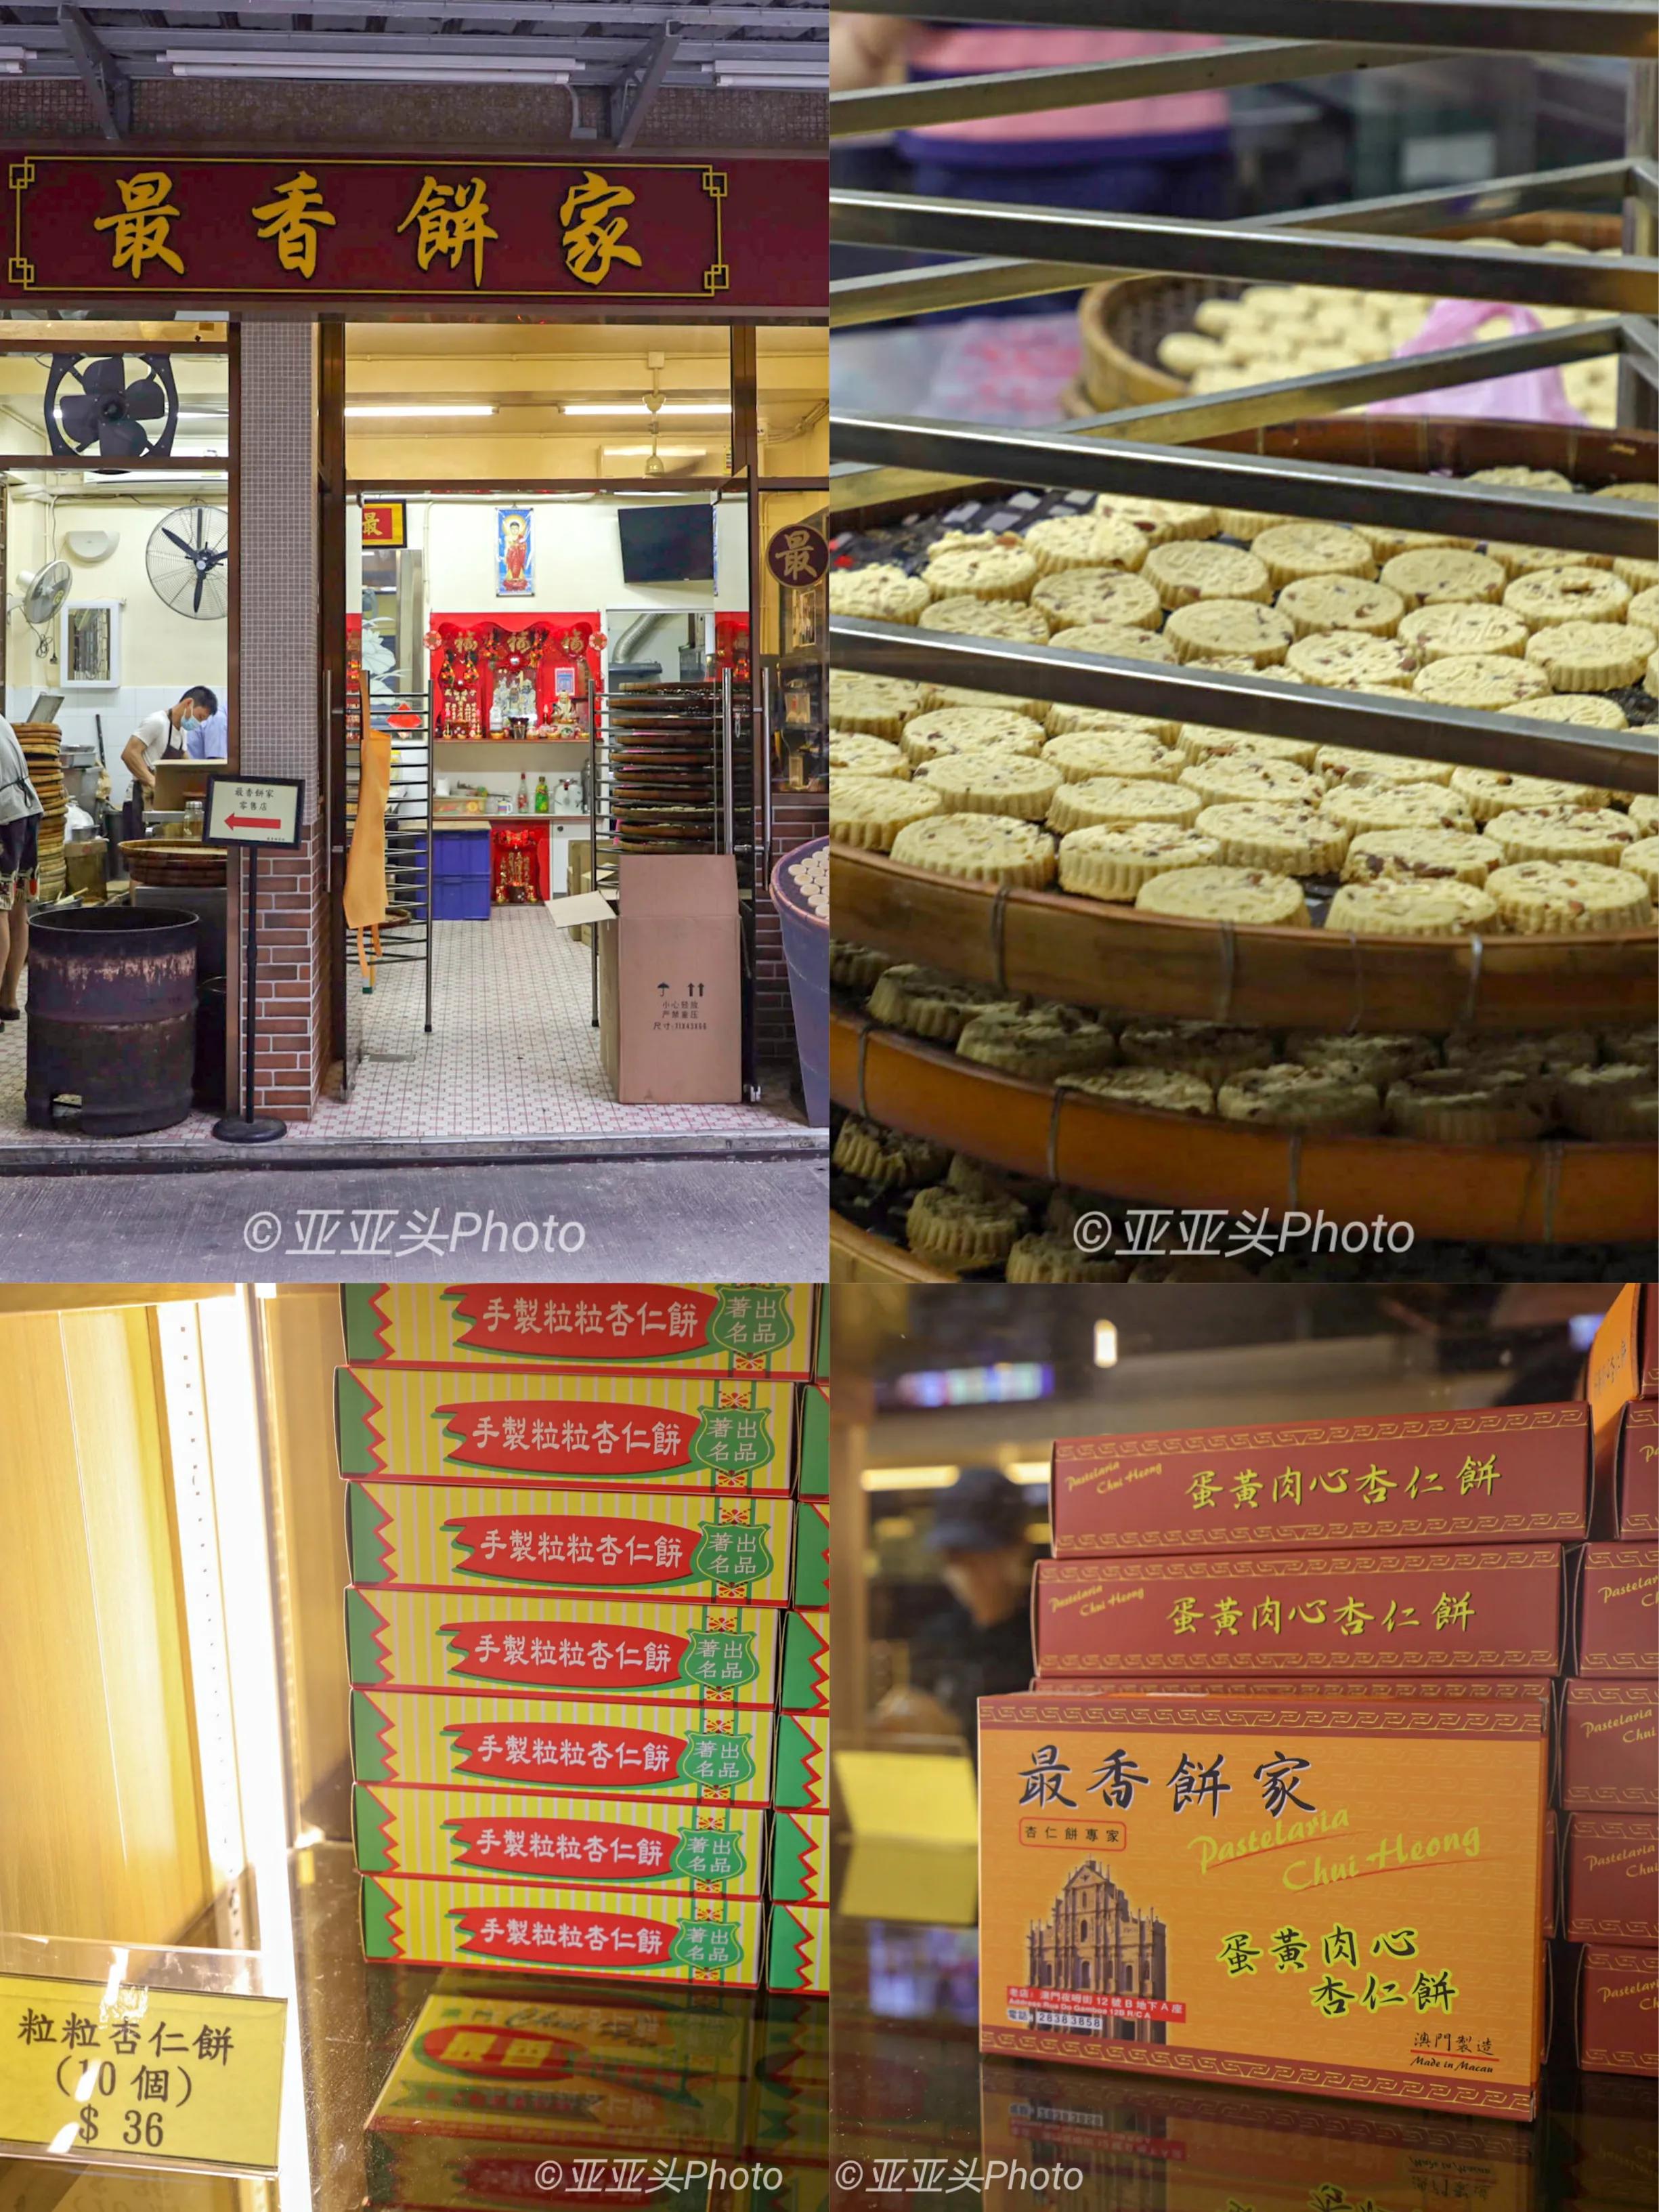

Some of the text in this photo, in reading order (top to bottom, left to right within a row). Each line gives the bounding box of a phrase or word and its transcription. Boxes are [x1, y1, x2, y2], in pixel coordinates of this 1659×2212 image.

[93, 170, 643, 289] 最香餅家
[775, 530, 817, 580] 最
[240, 801, 267, 811] 零售店
[483, 1297, 698, 1338] 手製粒粒杏仁餅
[473, 1416, 681, 1457] 手製粒粒杏仁餅
[1185, 1453, 1503, 1510] 蛋黃肉心杏仁餅
[480, 1529, 683, 1569] 手製粒粒杏仁餅
[1166, 1591, 1476, 1636] 蛋黃肉心杏仁餅
[475, 1634, 672, 1674] 手製粒粒杏仁餅
[1580, 1709, 1652, 1739] Pastelaria
[1622, 1726, 1657, 1743] Chui
[477, 1734, 670, 1772] 手製粒粒杏仁餅
[1018, 1744, 1316, 1818] 最香餅家
[477, 1828, 664, 1867] 手製粒粒杏仁餅
[1025, 1826, 1119, 1843] 杏仁餅專家
[1187, 1806, 1350, 1875] Pastelaria
[1283, 1827, 1480, 1890] Chui Heong
[1583, 1845, 1655, 1871] Pastelaria
[480, 1917, 663, 1956] 手製粒粒杏仁餅
[1218, 1924, 1417, 1976] 蛋黃肉心
[1310, 1970, 1459, 2017] 杏仁餅
[17, 2007, 234, 2066] 粒粒杏仁餅
[1414, 2032, 1494, 2056] 澳門製造
[1454, 2061, 1493, 2072] Macau
[123, 2110, 165, 2148] 36
